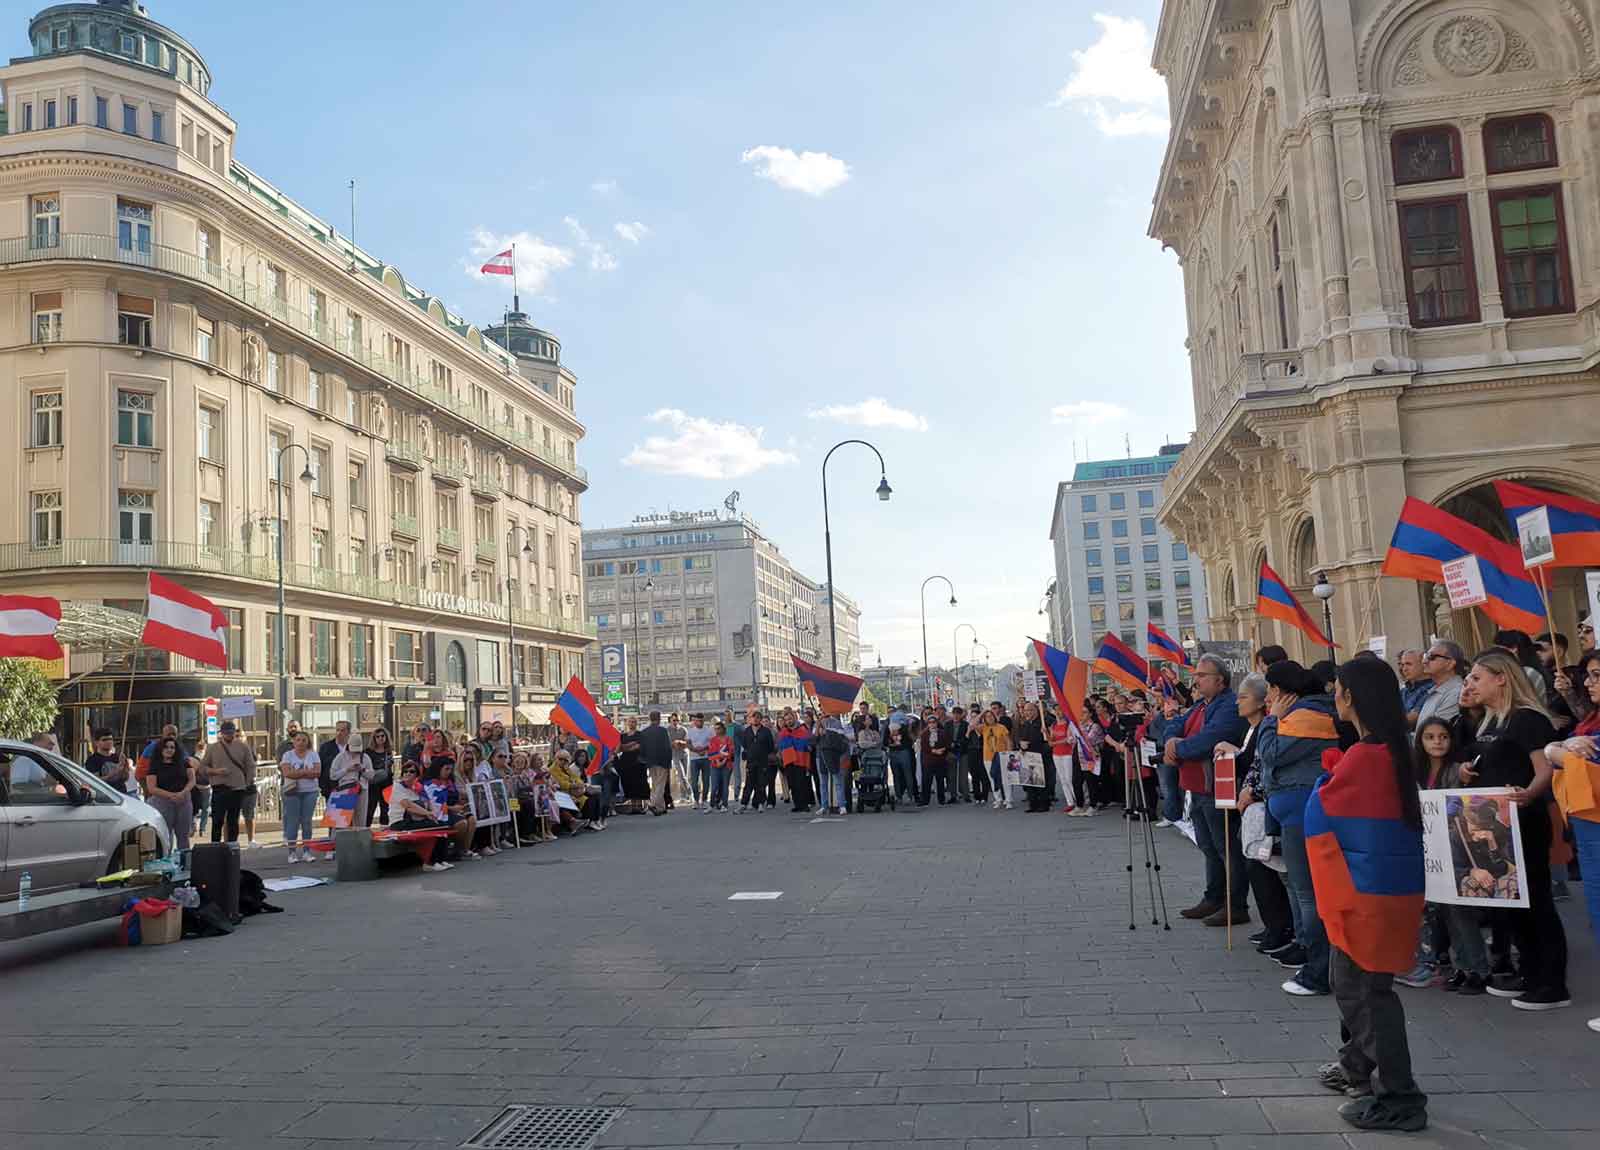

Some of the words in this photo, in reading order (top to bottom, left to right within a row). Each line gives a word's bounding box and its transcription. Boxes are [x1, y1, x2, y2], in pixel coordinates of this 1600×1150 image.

[419, 589, 457, 611] HOTEL
[464, 599, 507, 621] BRISTOL
[222, 685, 264, 696] STARBUCKS
